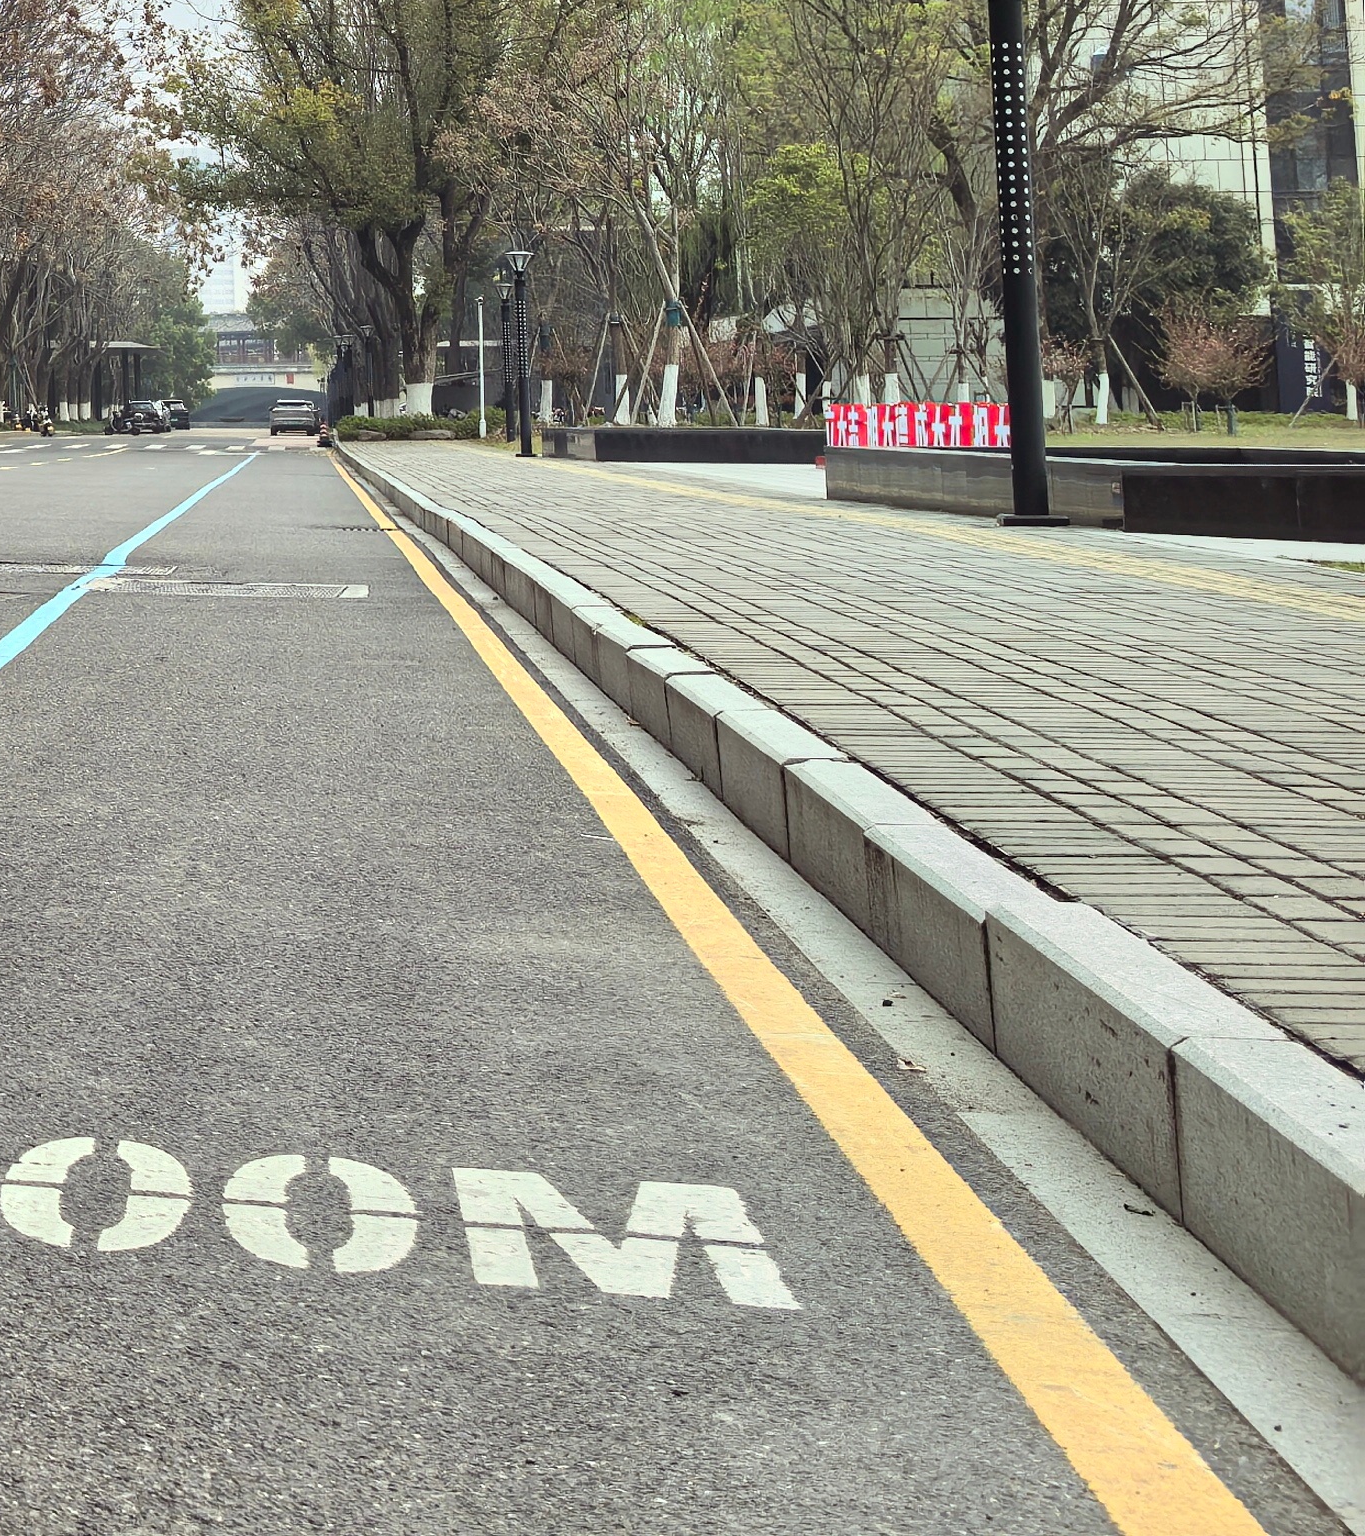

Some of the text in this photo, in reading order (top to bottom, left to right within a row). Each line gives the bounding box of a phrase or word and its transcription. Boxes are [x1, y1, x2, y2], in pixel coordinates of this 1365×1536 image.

[1302, 334, 1320, 398] 智能研究院
